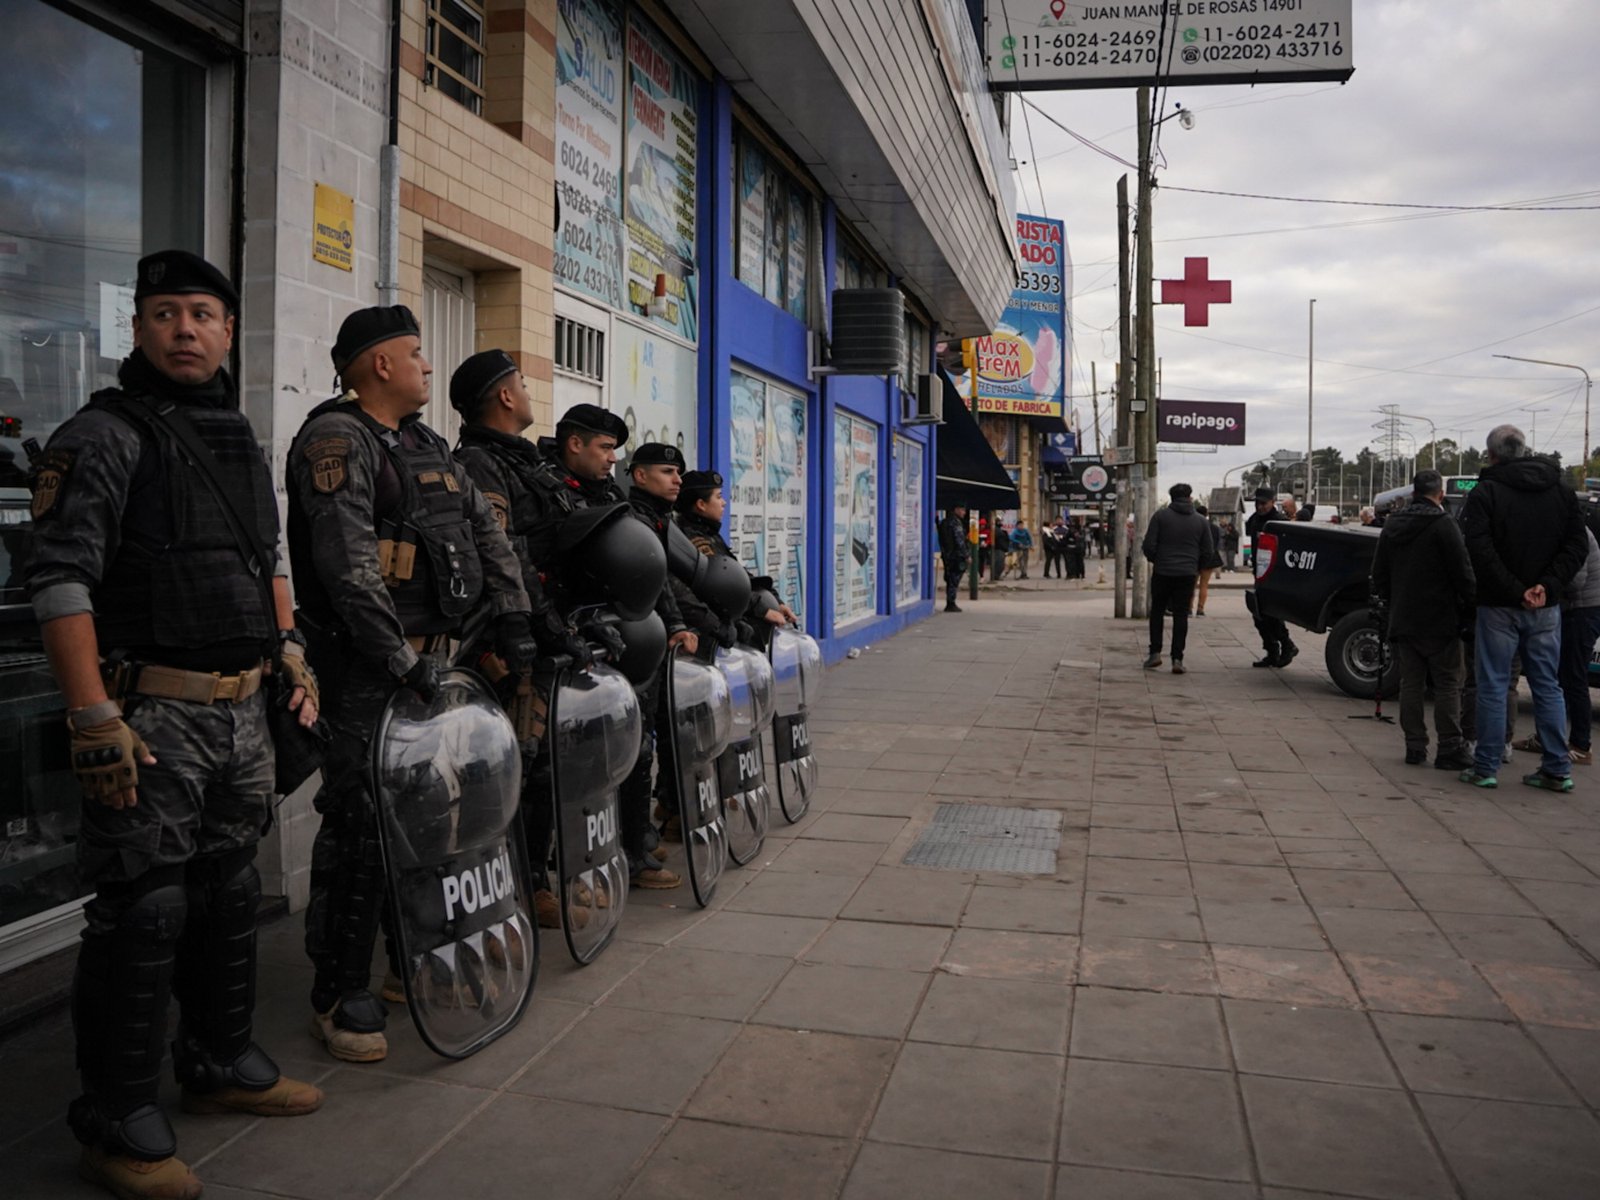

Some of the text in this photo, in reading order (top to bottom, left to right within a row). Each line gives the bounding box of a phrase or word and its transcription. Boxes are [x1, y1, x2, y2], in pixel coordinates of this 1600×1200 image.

[1082, 0, 1302, 20] JUAN MANUEL DE ROSAS 14901
[1022, 30, 1156, 50] 11-6024-2469
[1204, 22, 1340, 42] 11-6024-2471
[1022, 49, 1156, 67] 11-6024-2470
[1203, 41, 1343, 62] (02202) 433716
[574, 37, 615, 105] SALUD
[561, 140, 618, 199] 6024 2469
[564, 220, 592, 255] 6024
[583, 265, 618, 301] 433716
[1015, 271, 1060, 294] 5393
[977, 335, 1020, 356] Max
[995, 400, 1009, 411] DE
[1012, 401, 1052, 414] FABRICA
[1166, 412, 1236, 431] rapipago
[315, 459, 341, 474] GAD
[1298, 550, 1317, 570] 911
